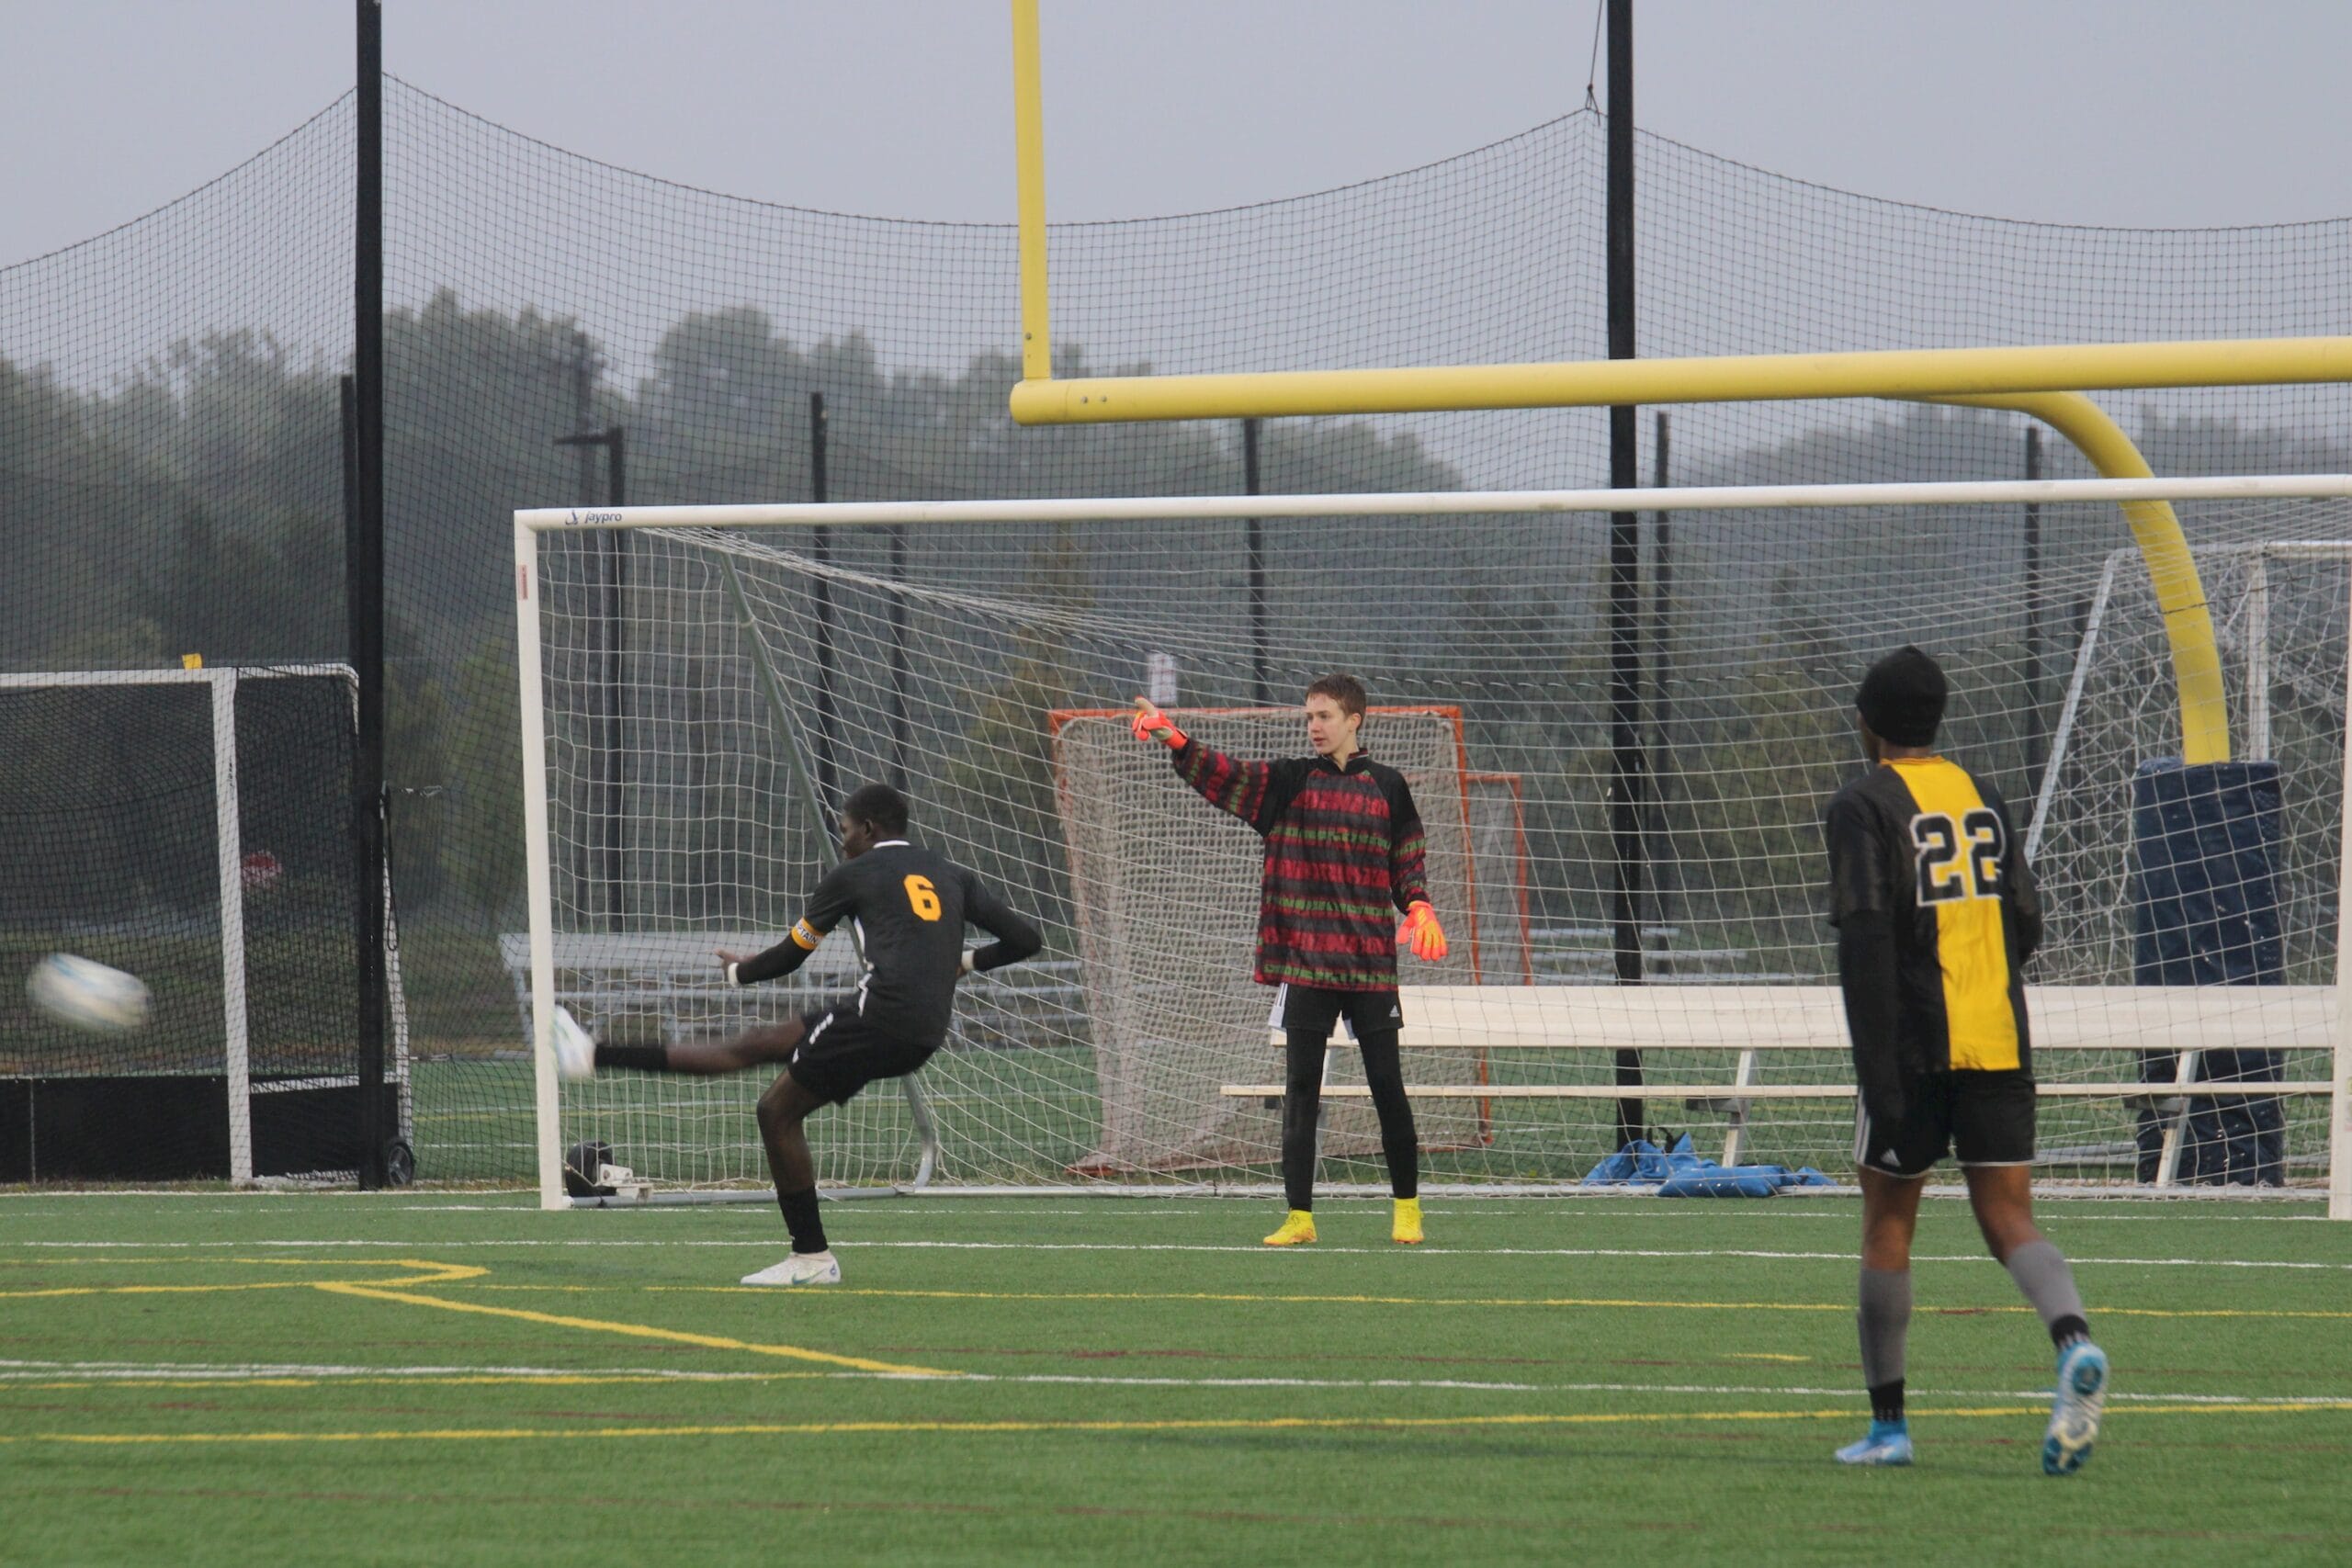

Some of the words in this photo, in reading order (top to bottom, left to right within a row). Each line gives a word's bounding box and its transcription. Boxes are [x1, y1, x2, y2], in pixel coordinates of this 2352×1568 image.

[584, 511, 622, 524] jaypro
[1910, 807, 2007, 908] 22
[903, 874, 942, 921] 6
